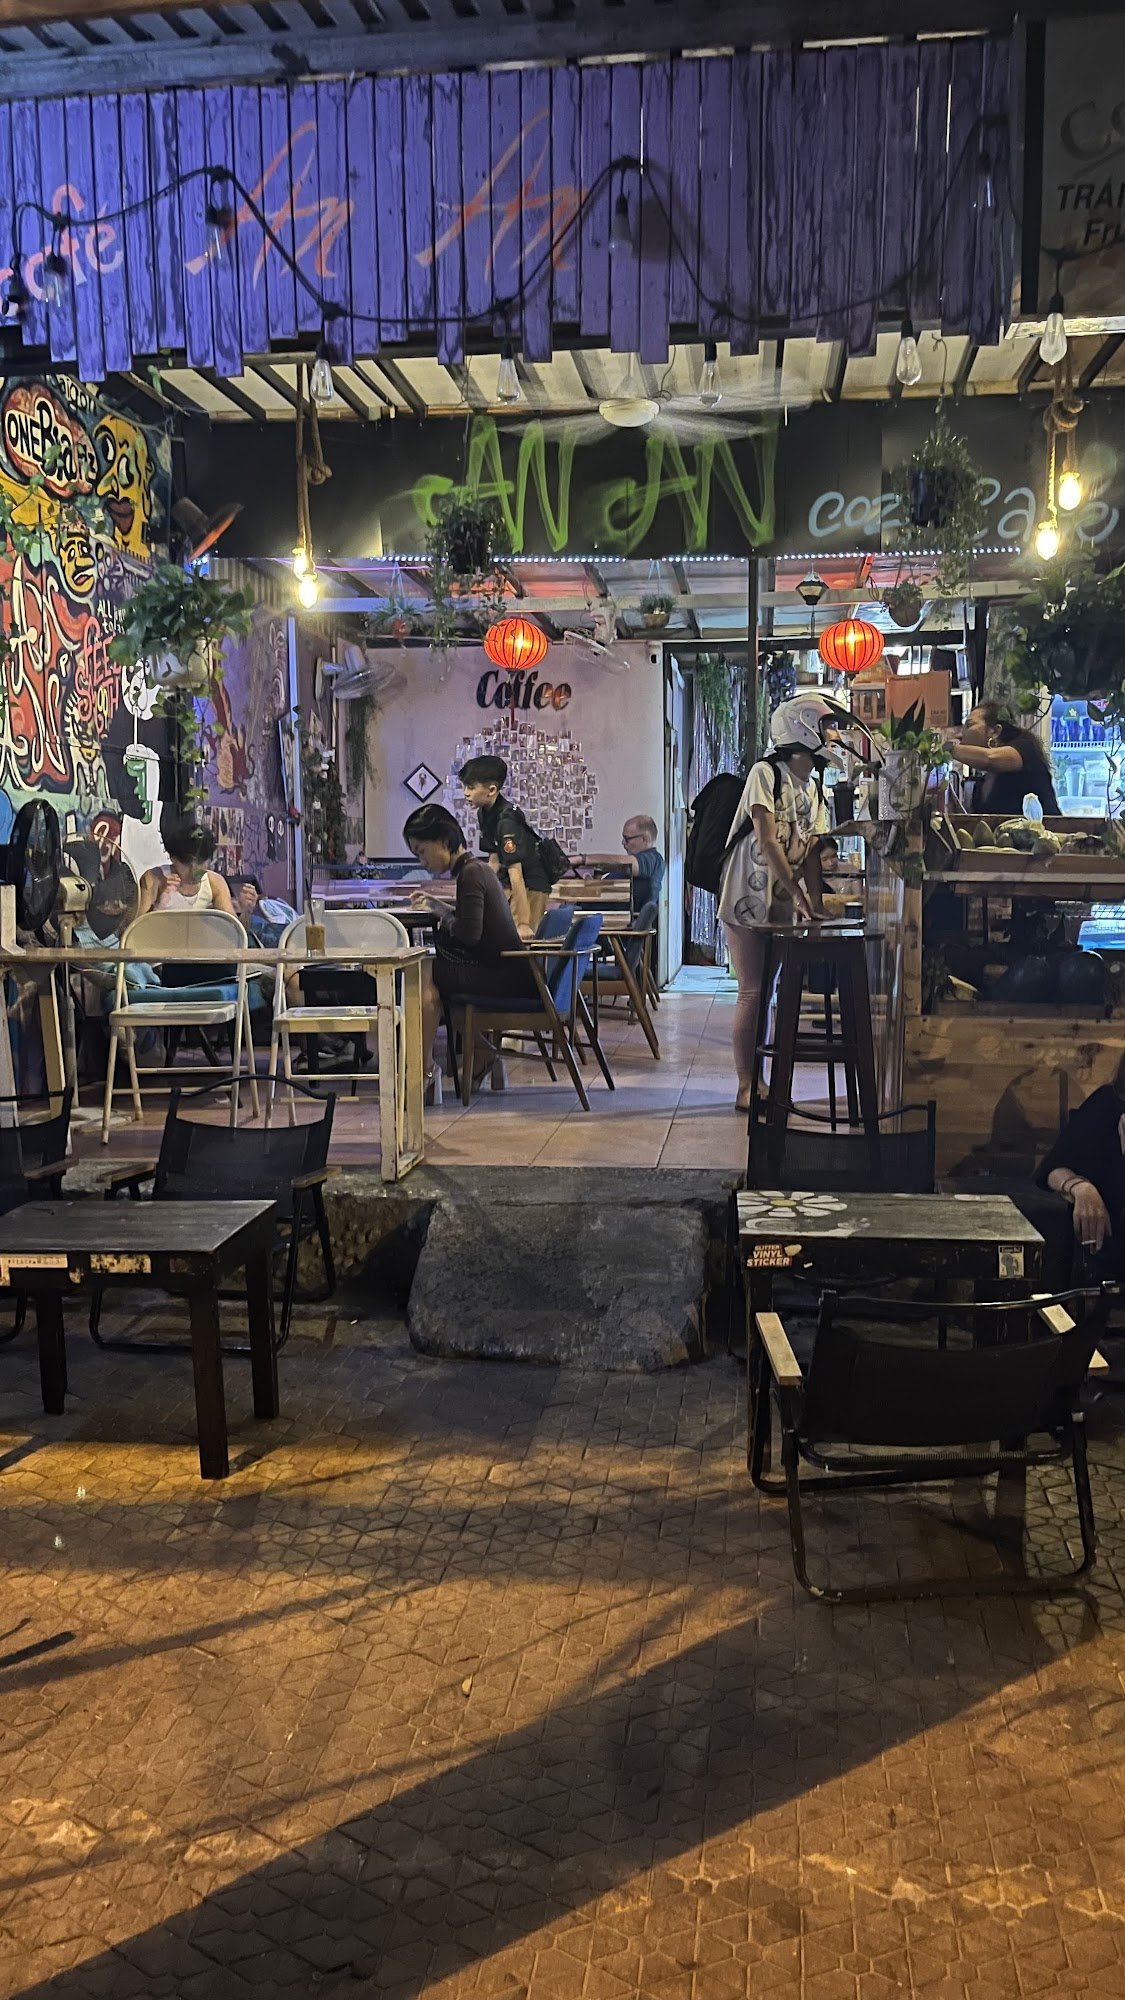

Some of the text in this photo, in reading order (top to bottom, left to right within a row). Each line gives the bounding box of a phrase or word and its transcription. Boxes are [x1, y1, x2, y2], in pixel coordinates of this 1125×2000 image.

[0, 108, 588, 302] afé An An
[48, 375, 97, 415] aigon
[7, 412, 43, 463] ONE
[808, 477, 1120, 544] Coz ae
[476, 669, 572, 711] Coffee
[746, 1257, 790, 1267] STICKER
[753, 1250, 782, 1258] VINYL
